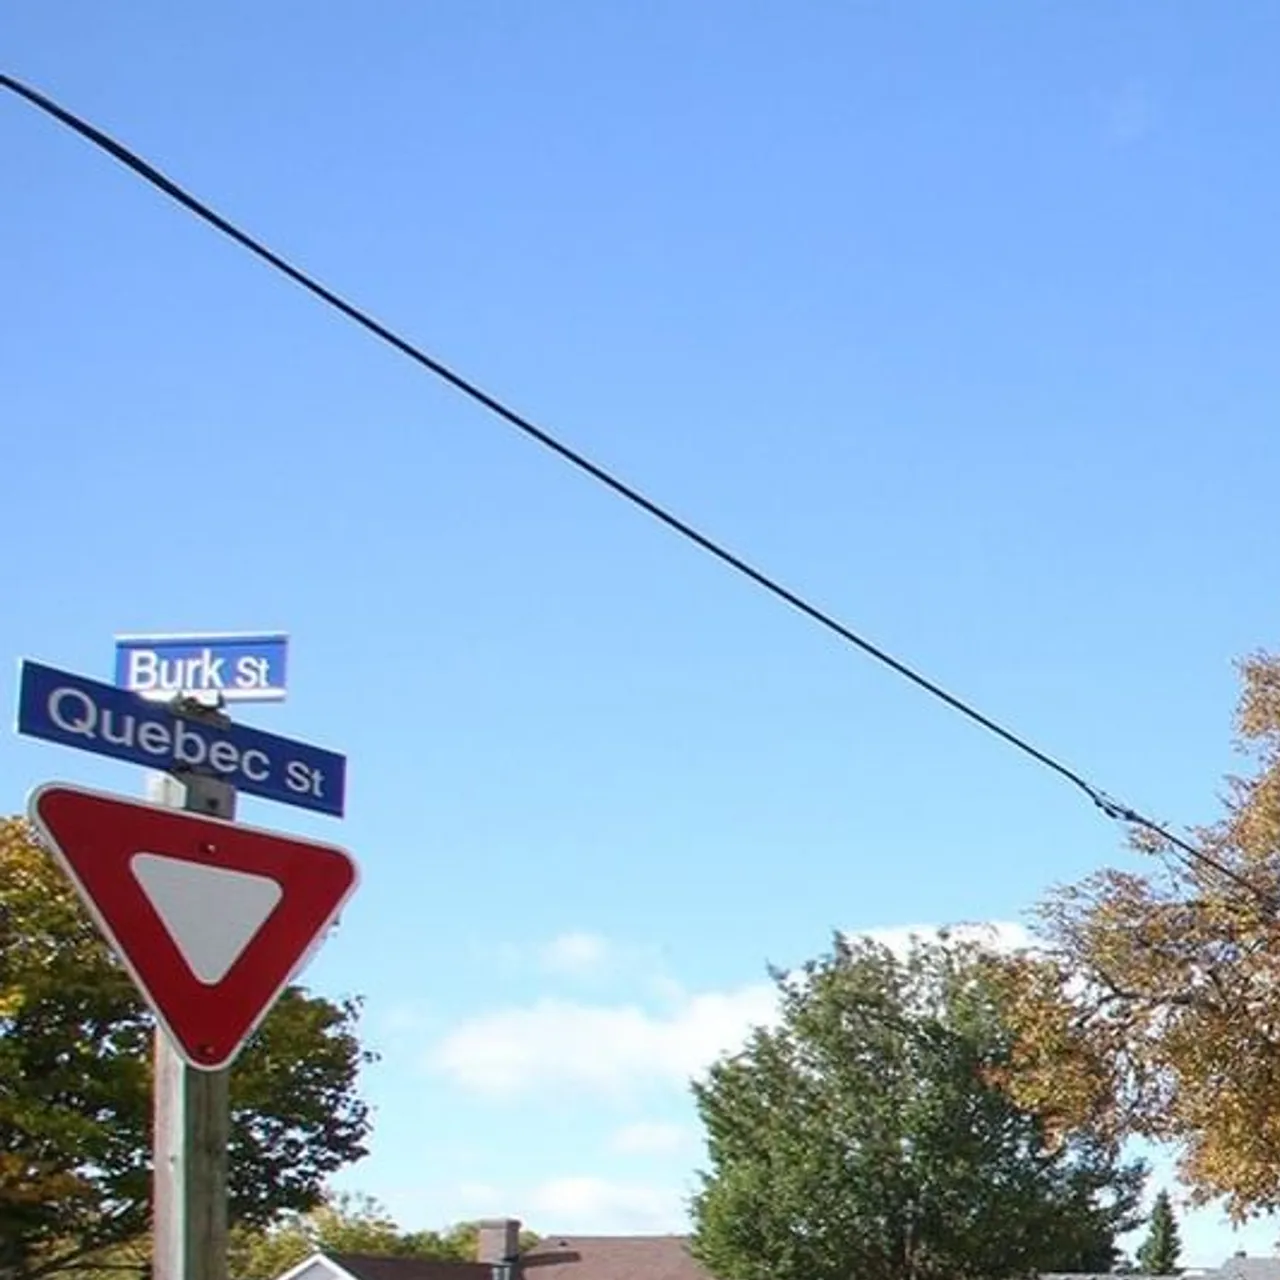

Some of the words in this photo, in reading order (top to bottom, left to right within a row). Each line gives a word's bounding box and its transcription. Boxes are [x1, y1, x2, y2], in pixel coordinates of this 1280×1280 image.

[129, 648, 225, 690] Burk
[235, 656, 270, 689] St
[47, 687, 271, 782] Quebec
[285, 762, 325, 798] St
